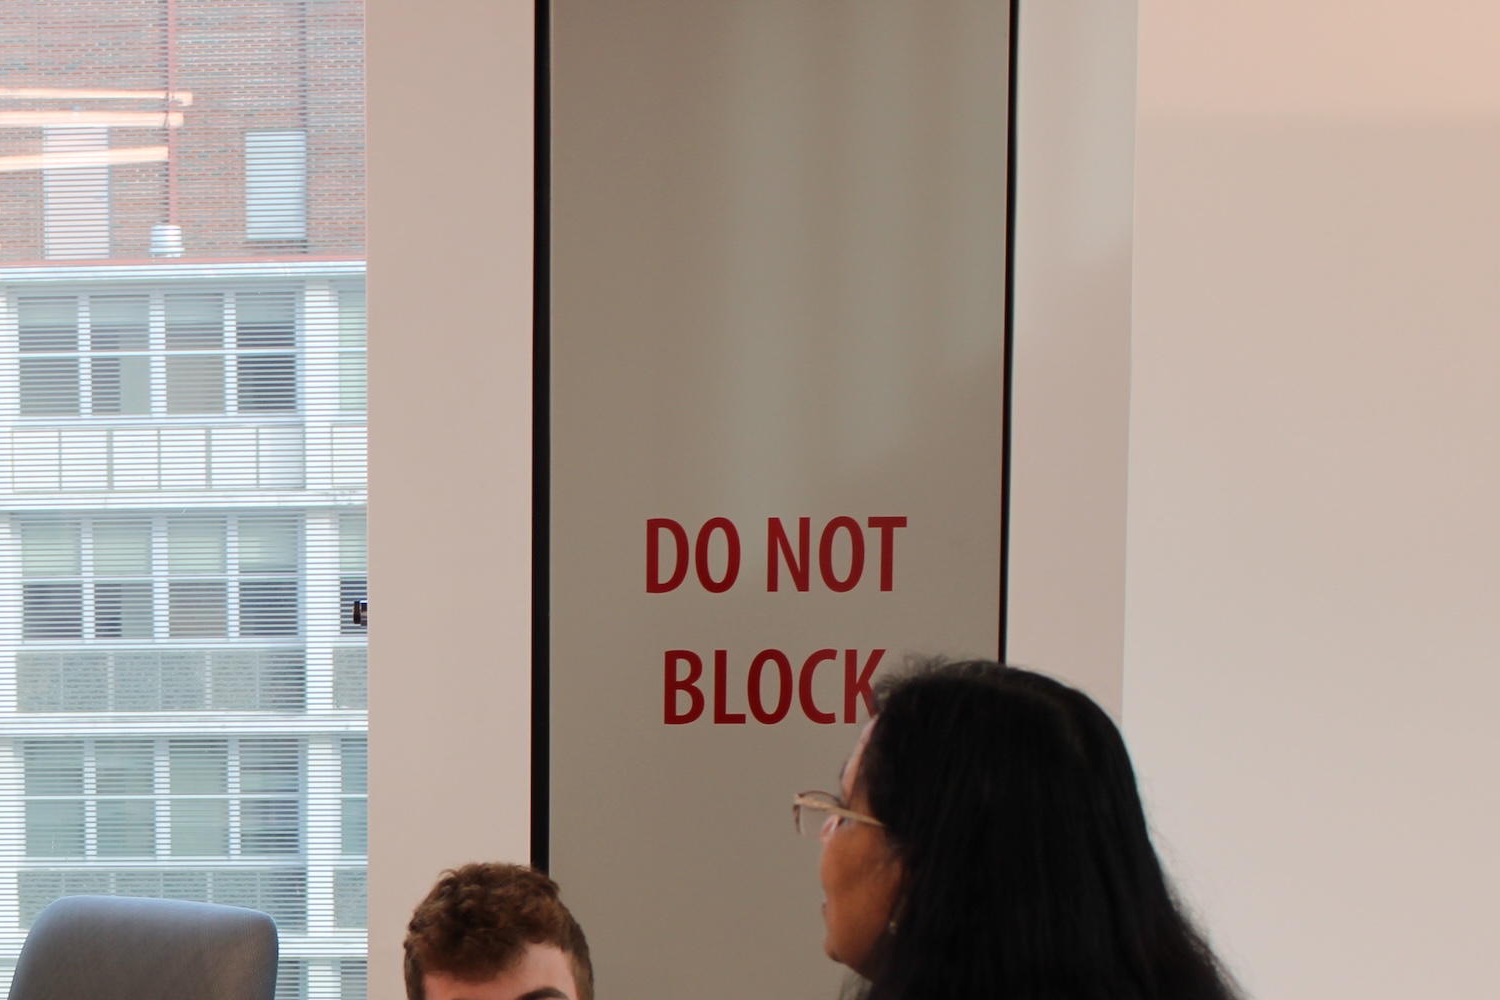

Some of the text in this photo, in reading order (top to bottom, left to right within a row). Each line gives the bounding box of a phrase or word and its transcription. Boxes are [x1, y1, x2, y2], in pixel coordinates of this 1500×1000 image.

[646, 515, 907, 594] DO NOT
[664, 648, 886, 725] BLOCK
